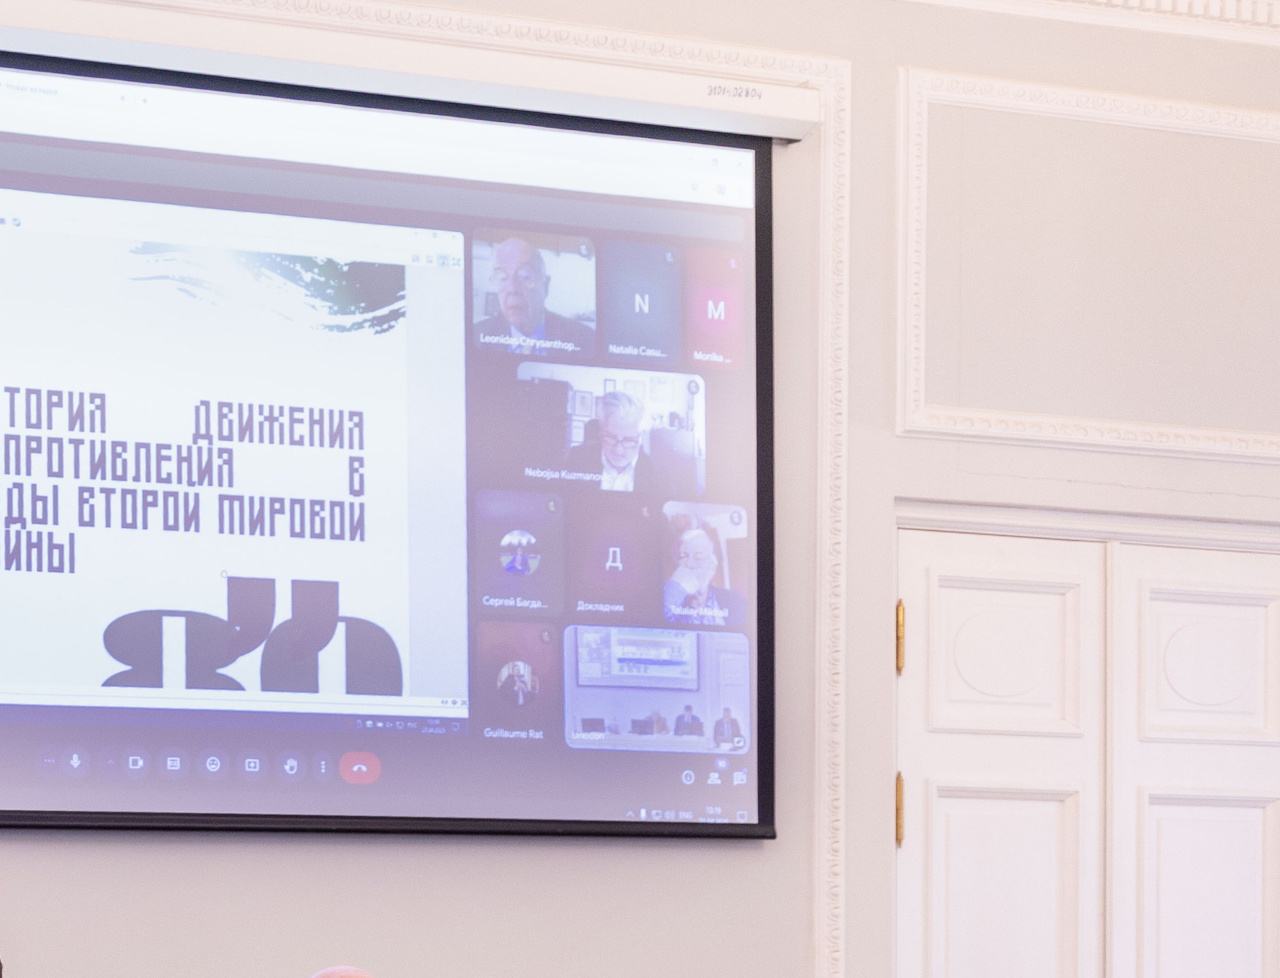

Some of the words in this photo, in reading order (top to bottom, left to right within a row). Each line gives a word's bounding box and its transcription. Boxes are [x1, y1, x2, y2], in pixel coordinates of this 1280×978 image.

[634, 293, 650, 313] N
[707, 300, 725, 320] M
[480, 333, 519, 345] Leonidas
[192, 399, 364, 450] ДВИЖЕНИЯ
[348, 456, 364, 495] В
[605, 547, 623, 571] Д
[482, 595, 515, 608] Сергей
[576, 600, 625, 612] Докладчик
[483, 727, 527, 739] Guillaume
